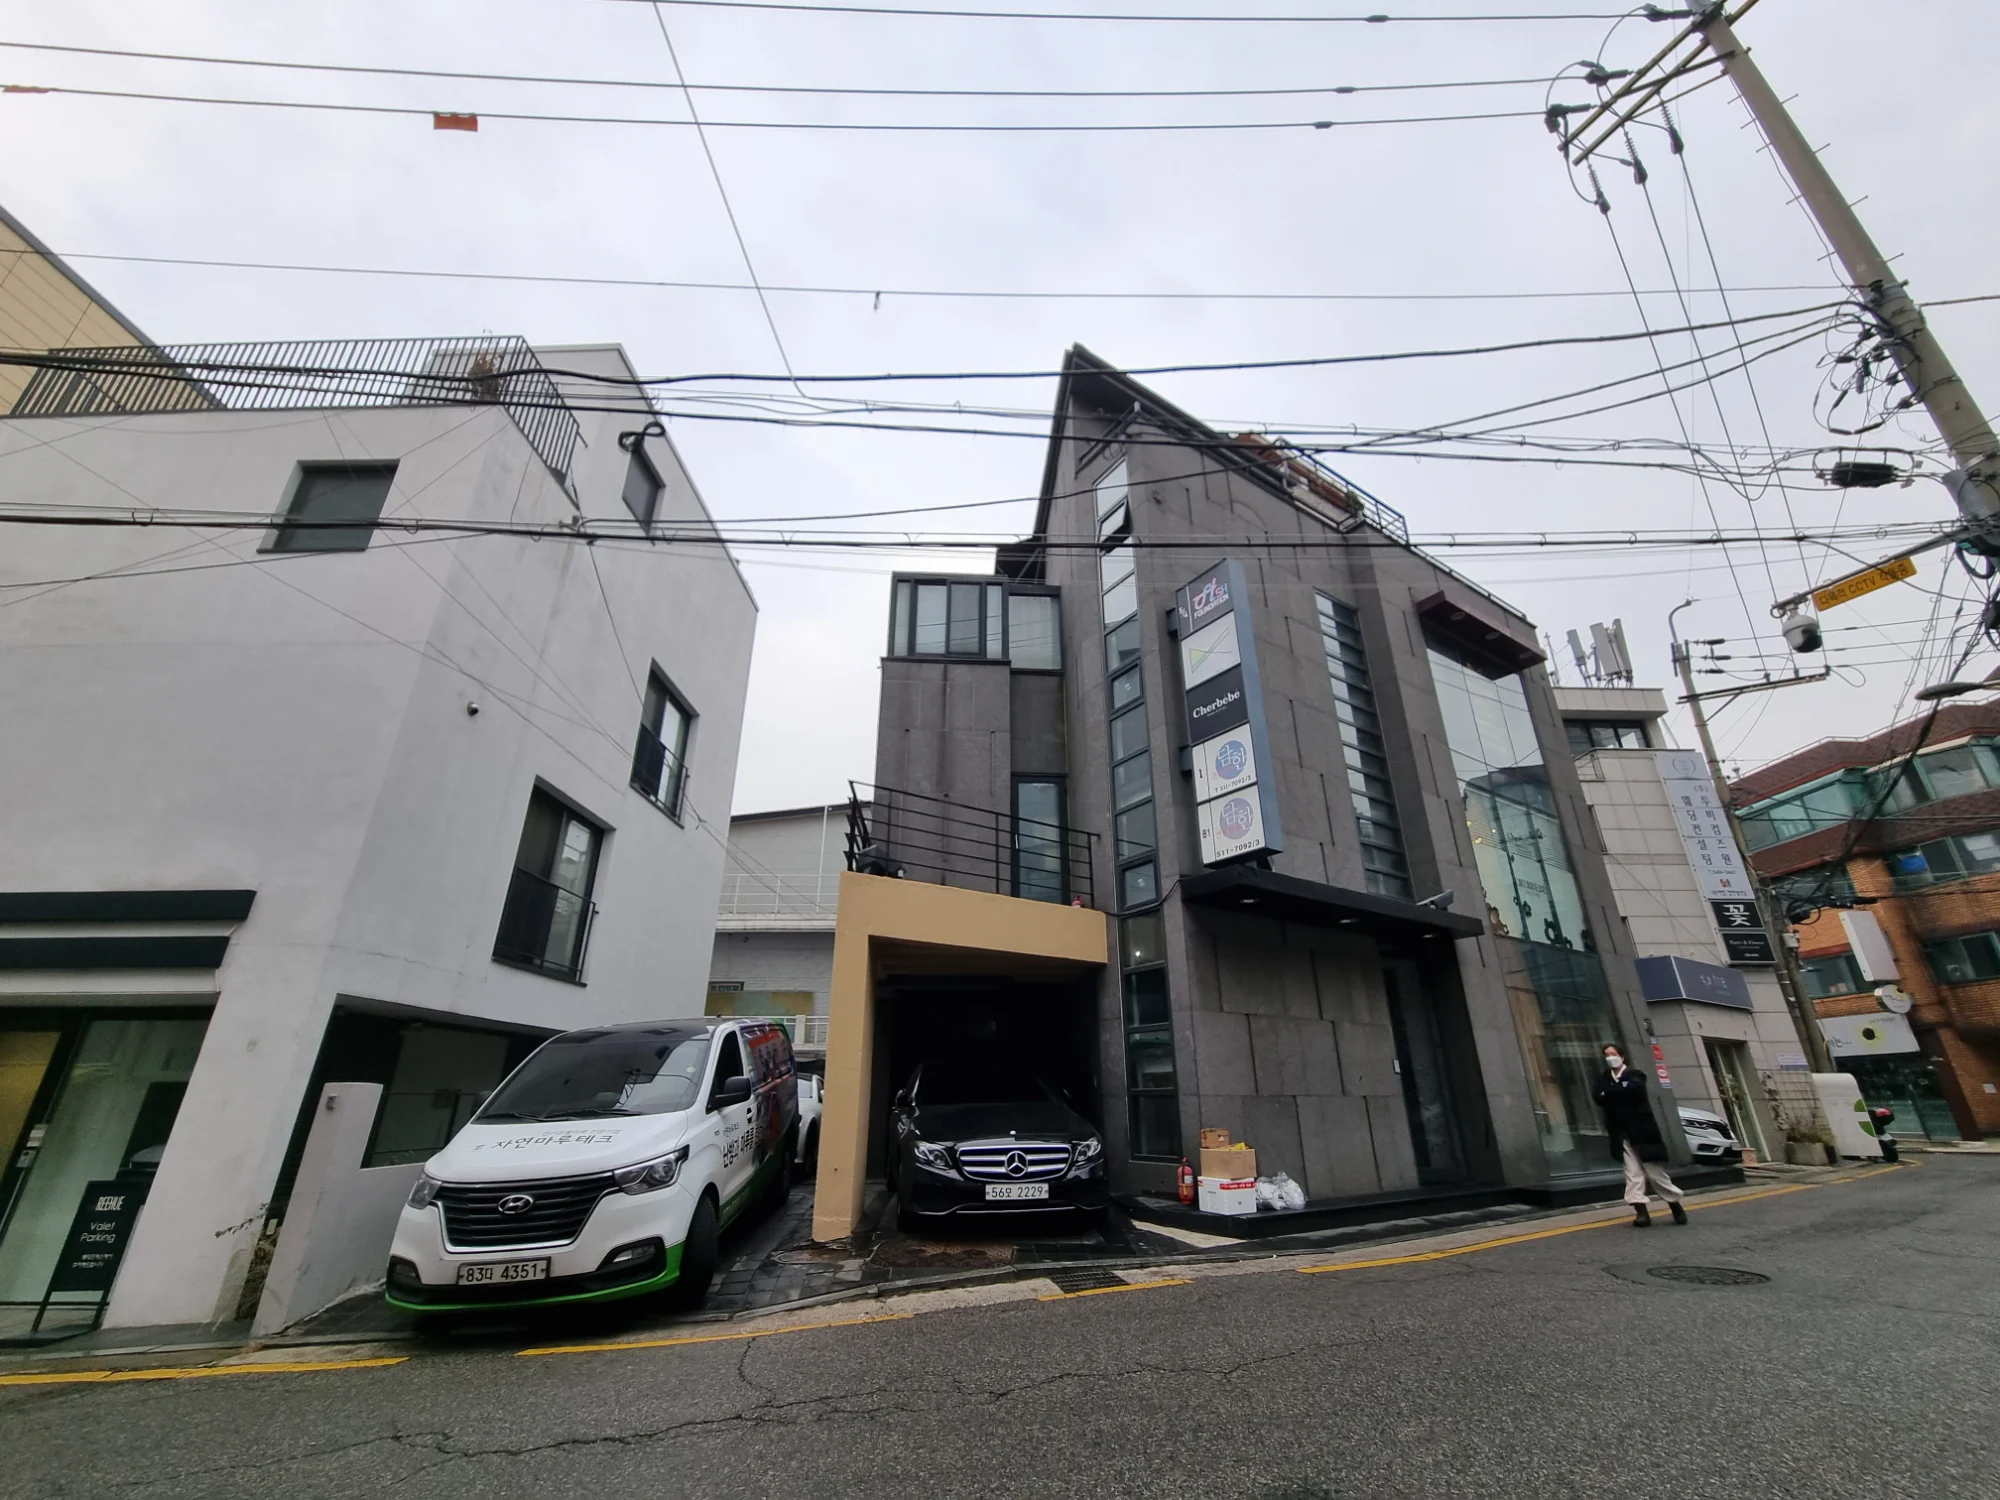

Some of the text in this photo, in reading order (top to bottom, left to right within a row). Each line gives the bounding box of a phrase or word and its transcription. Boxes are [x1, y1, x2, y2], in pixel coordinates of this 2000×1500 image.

[1848, 576, 1877, 594] CCTV
[1193, 593, 1230, 620] FOUNDATION
[1217, 744, 1248, 771] 담한
[1221, 801, 1254, 831] 담한
[1202, 828, 1212, 839] B1
[1216, 838, 1261, 858] 511-7092/3
[1722, 904, 1751, 927] 꽃
[991, 1185, 1044, 1198] 56모 2229
[90, 1221, 116, 1231] Valet
[80, 1232, 116, 1244] Parking
[465, 1263, 538, 1282] 83다 4351
